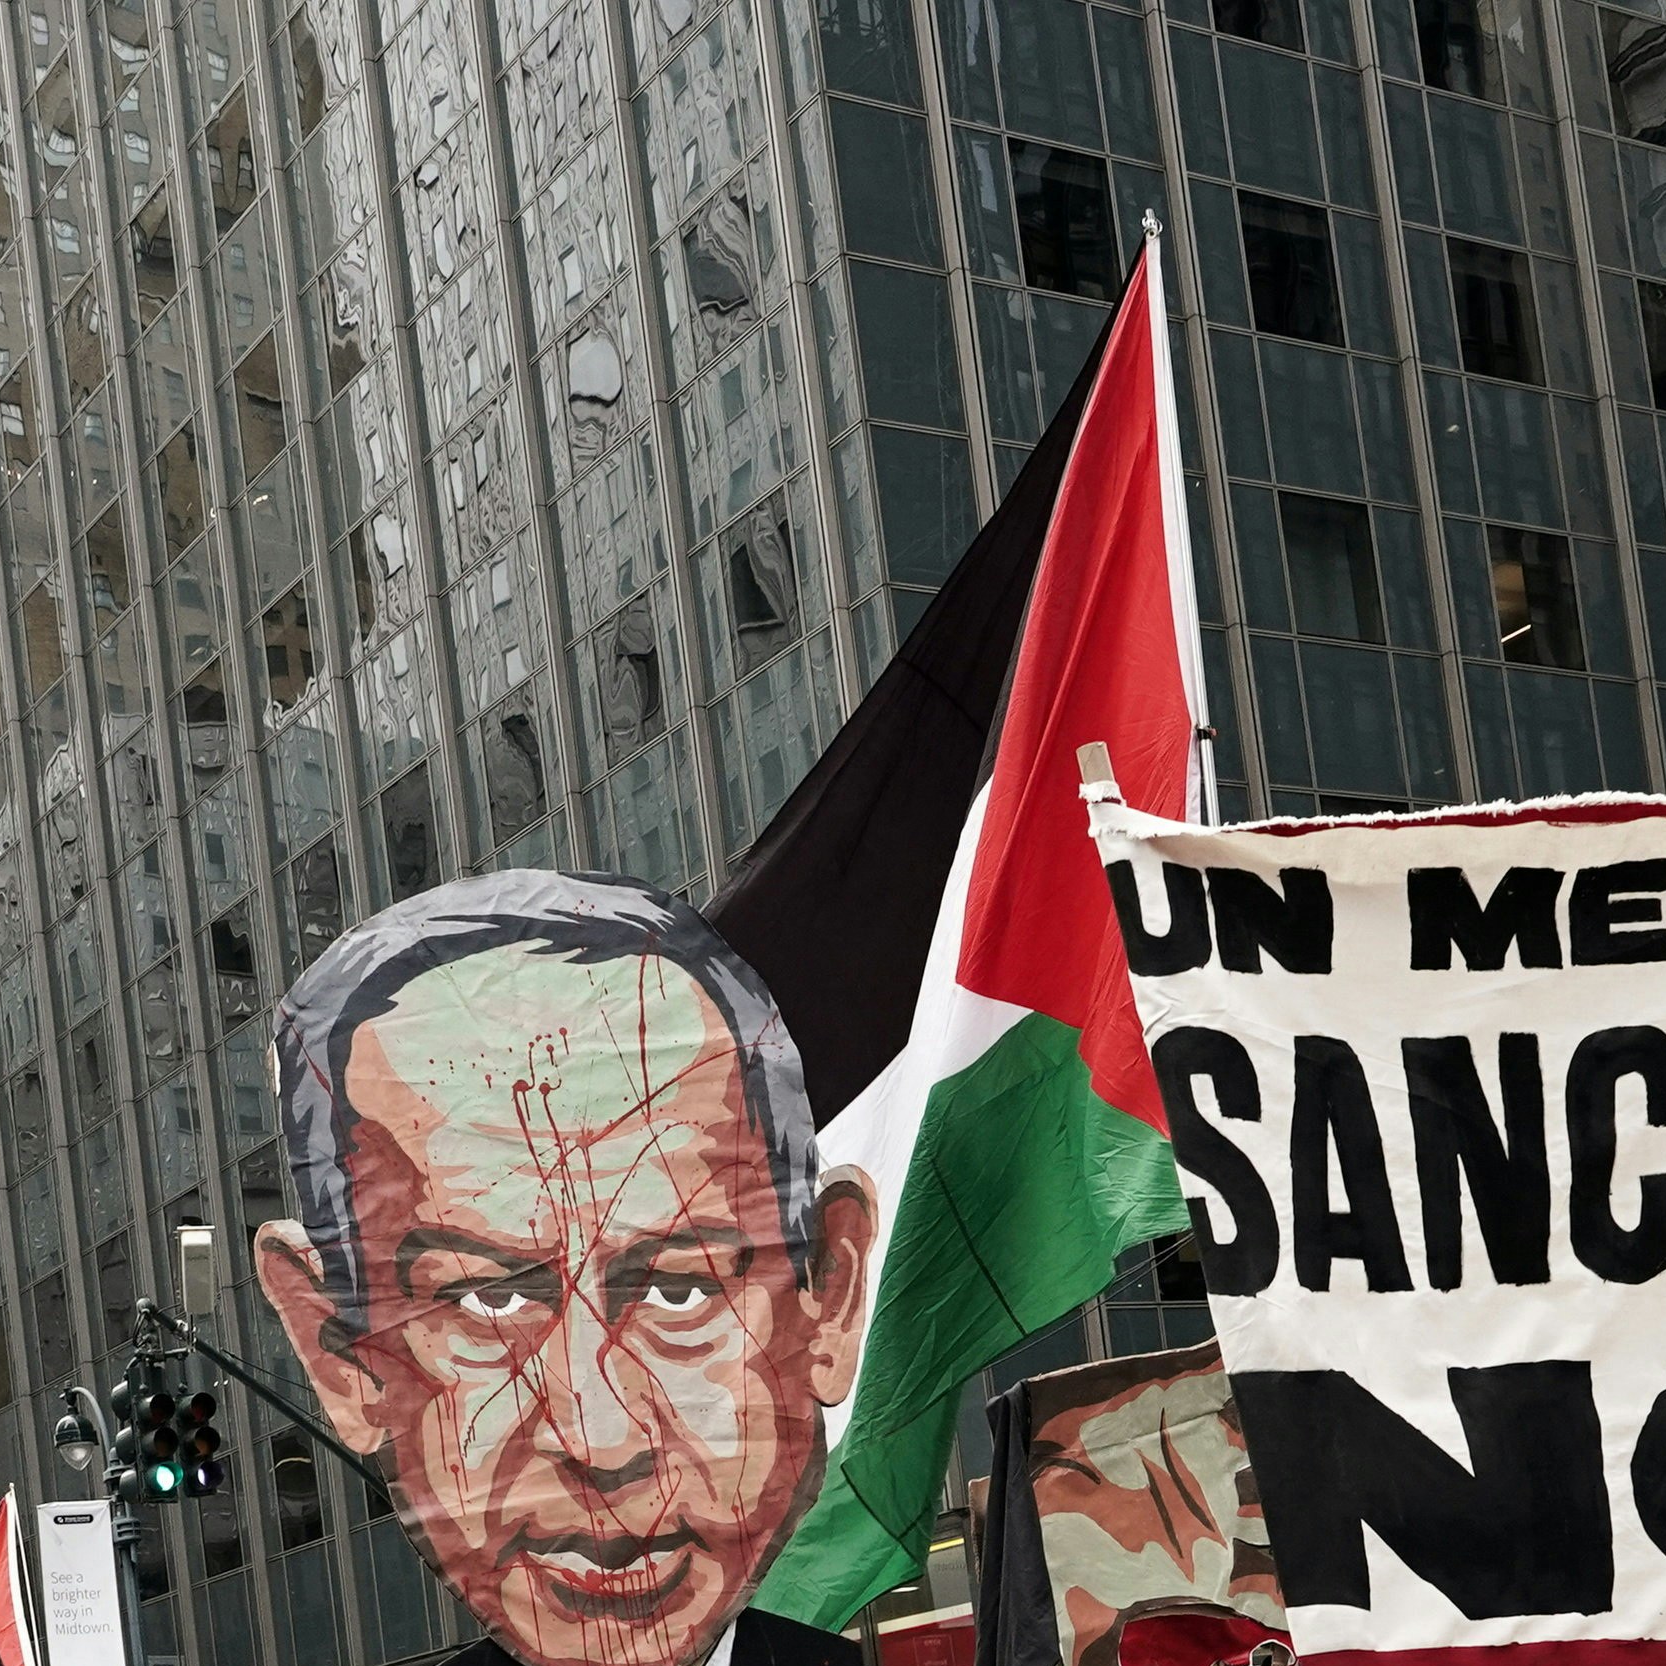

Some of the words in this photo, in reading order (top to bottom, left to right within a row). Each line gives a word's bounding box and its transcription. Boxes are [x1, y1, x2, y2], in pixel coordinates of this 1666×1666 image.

[1106, 858, 1333, 975] UN
[51, 1571, 73, 1584] See
[76, 1574, 84, 1584] a
[52, 1588, 102, 1604] brighter
[53, 1609, 79, 1621] way
[81, 1606, 93, 1617] in
[55, 1621, 115, 1636] Midtown.
